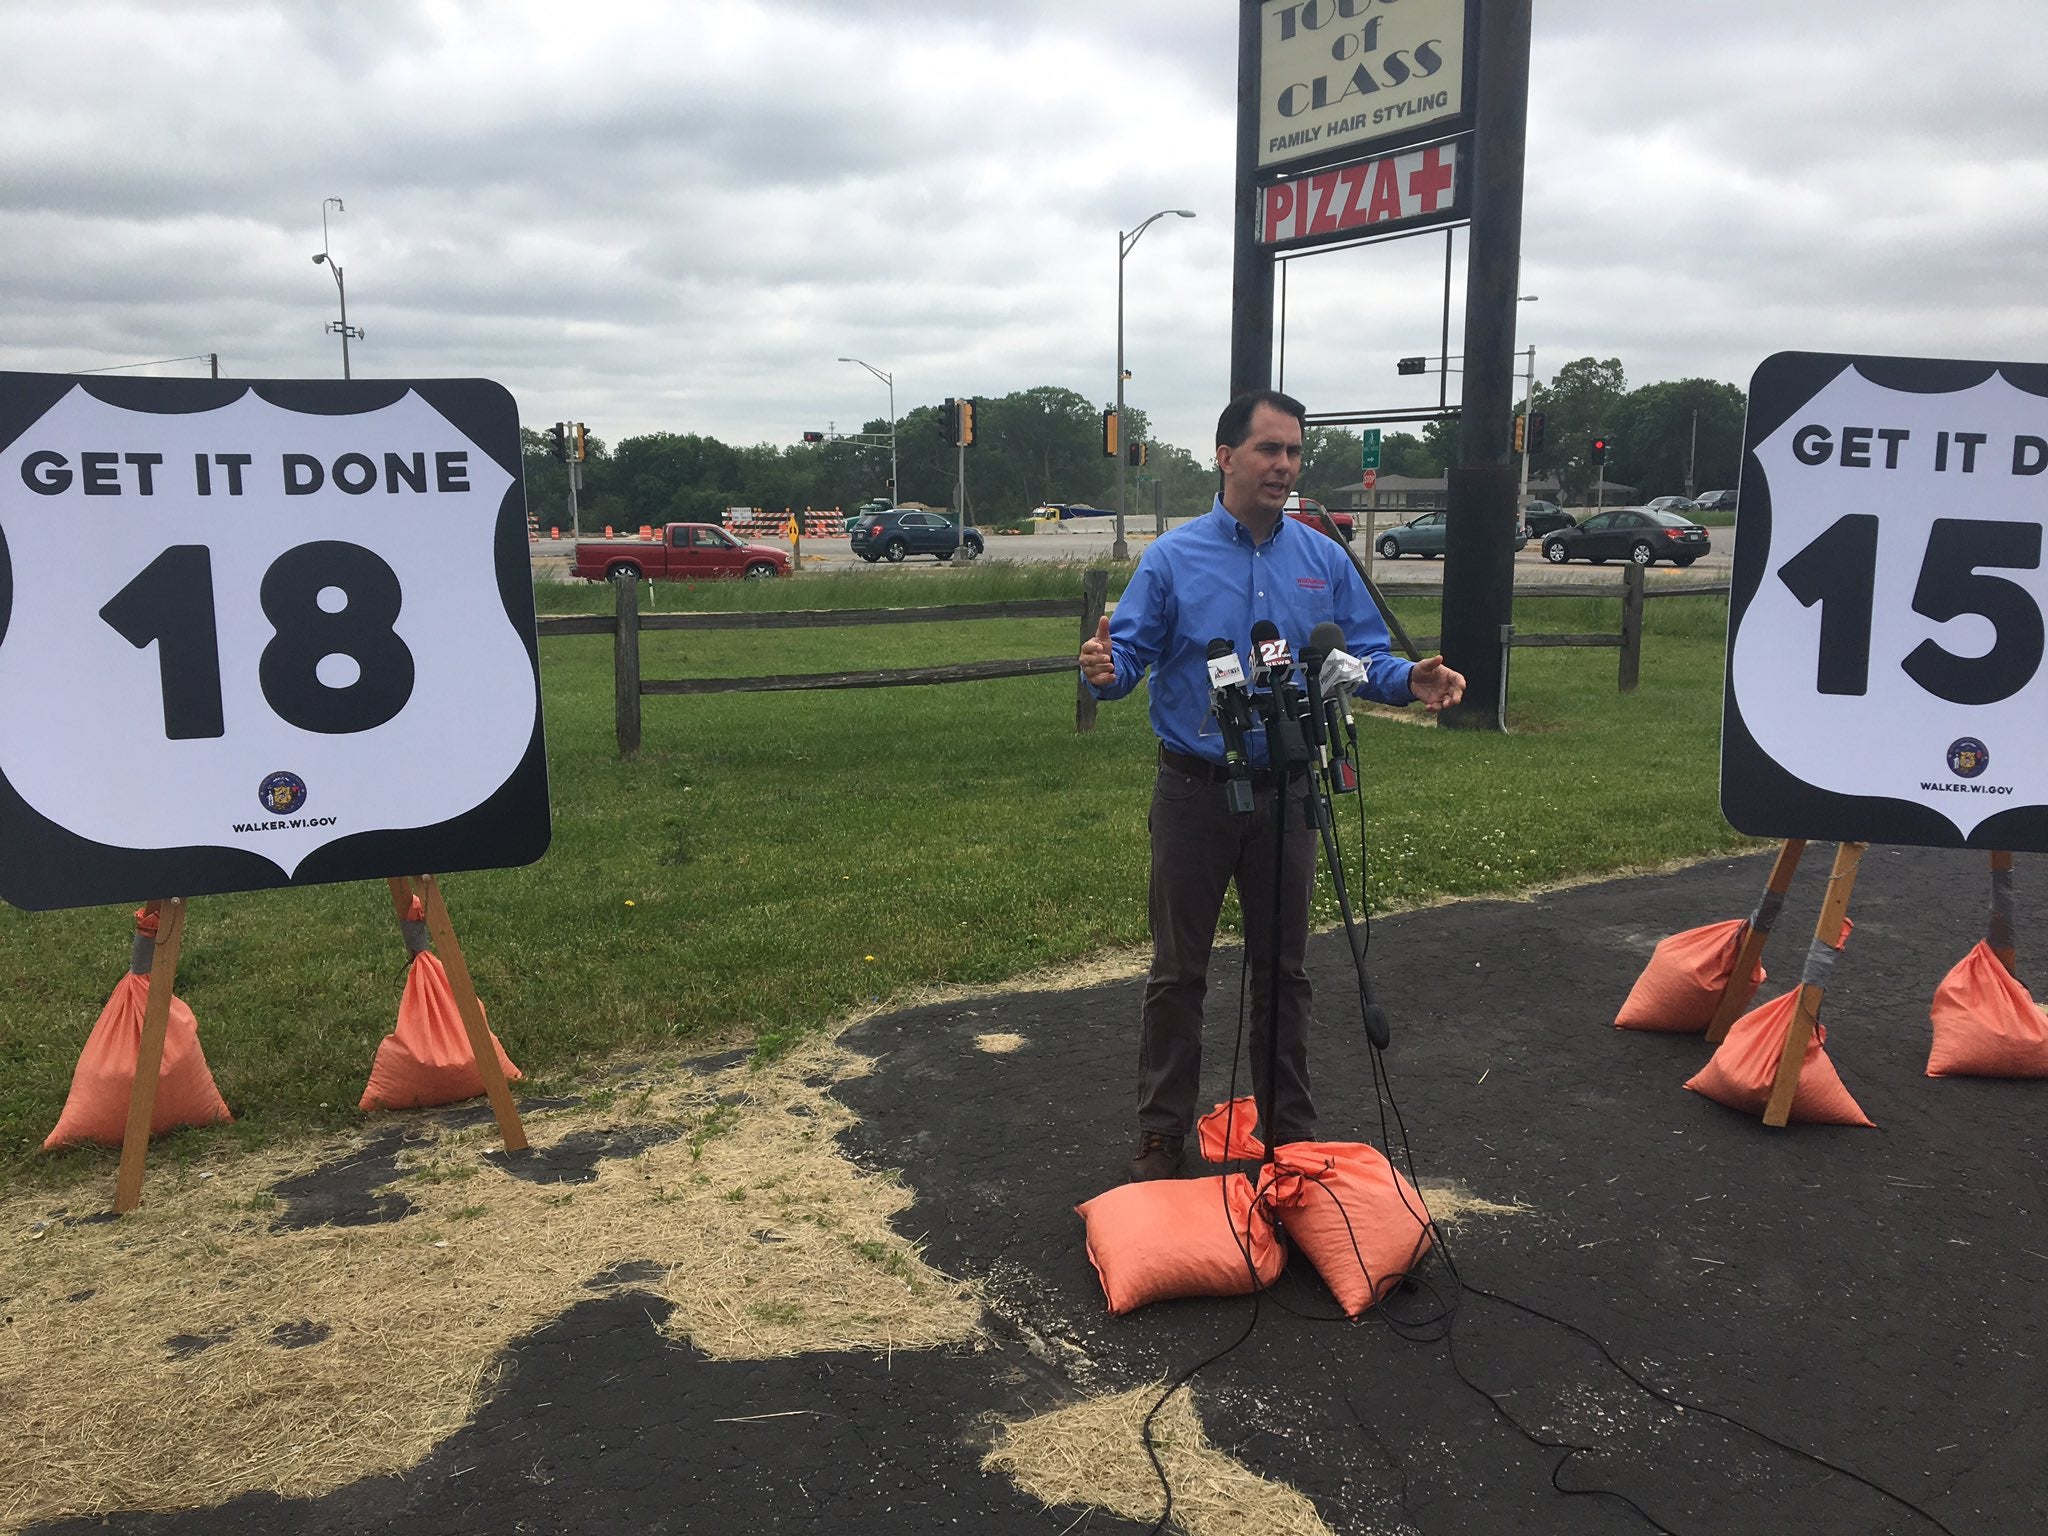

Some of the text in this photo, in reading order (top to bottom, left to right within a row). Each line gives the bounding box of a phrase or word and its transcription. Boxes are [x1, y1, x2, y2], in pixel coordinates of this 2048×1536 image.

[1332, 15, 1384, 61] of
[1277, 39, 1442, 117] CLASS
[1269, 90, 1448, 153] FAMILY HAIR STYLING
[1792, 424, 1910, 470] GET
[1935, 431, 1987, 473] IT
[21, 450, 471, 496] GET IT DONE
[1777, 513, 2045, 706] 15
[99, 540, 415, 740] 18
[1260, 638, 1287, 662] 27
[1265, 659, 1291, 667] NEWS
[1920, 782, 2013, 795] WALKER.WI.GOV
[232, 816, 337, 833] WALKER.WI.GOV
